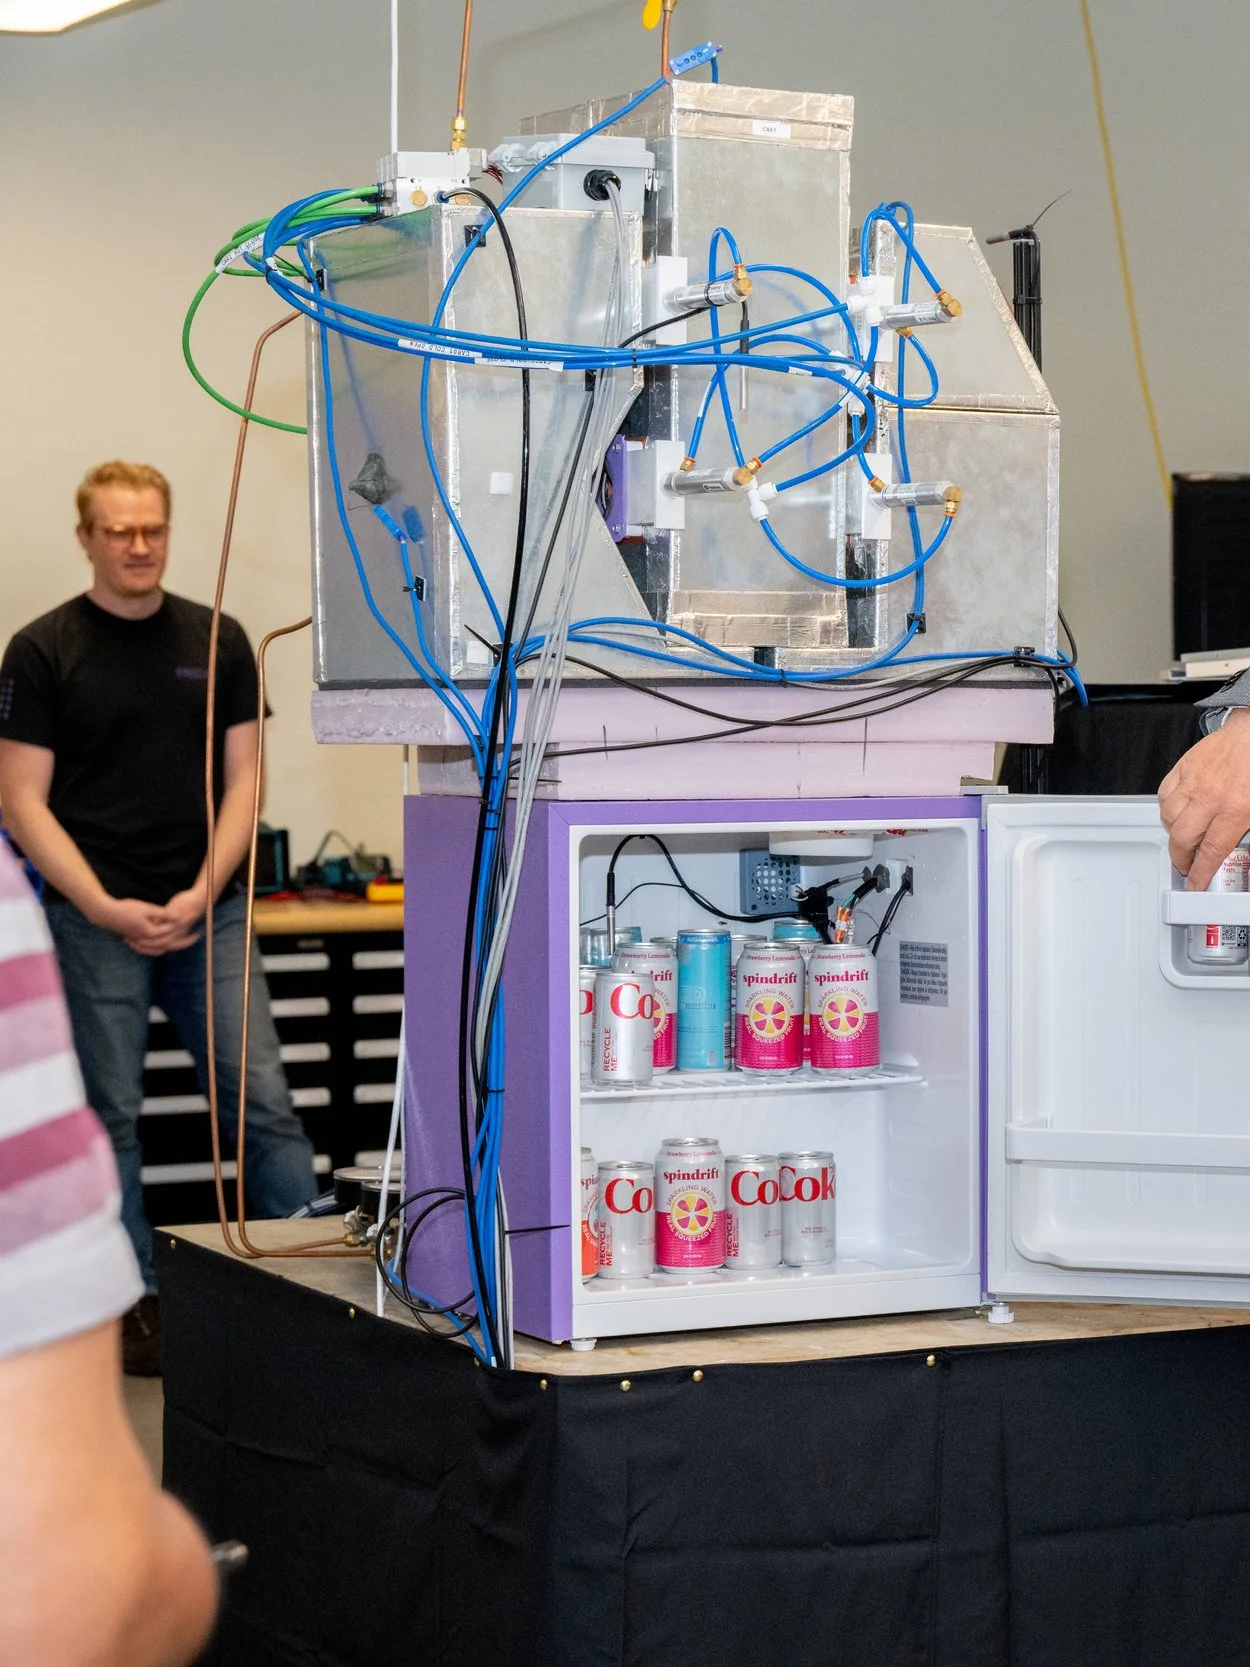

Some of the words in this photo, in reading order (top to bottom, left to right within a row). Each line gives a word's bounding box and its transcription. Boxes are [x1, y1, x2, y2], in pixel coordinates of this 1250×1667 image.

[409, 341, 426, 349] OPEN
[428, 344, 446, 353] COLD
[742, 972, 797, 987] spindrift
[814, 970, 869, 986] spindrift
[745, 988, 776, 1009] SPARKLING
[778, 990, 795, 1009] WATER
[818, 986, 849, 1008] SPARKLING
[850, 988, 868, 1007] WATER
[752, 1033, 785, 1044] SQUEEZED
[784, 1017, 795, 1035] FRUIT
[826, 1033, 860, 1043] SQUEEZED
[603, 1027, 611, 1072] RECYCLE
[610, 1056, 618, 1072] ME
[663, 1168, 719, 1184] spindrift
[667, 1185, 699, 1206] SPARKLING
[701, 1186, 718, 1205] WATER
[674, 1231, 709, 1242] SQUEEZED
[606, 1250, 613, 1266] ME
[732, 1243, 739, 1257] ME
